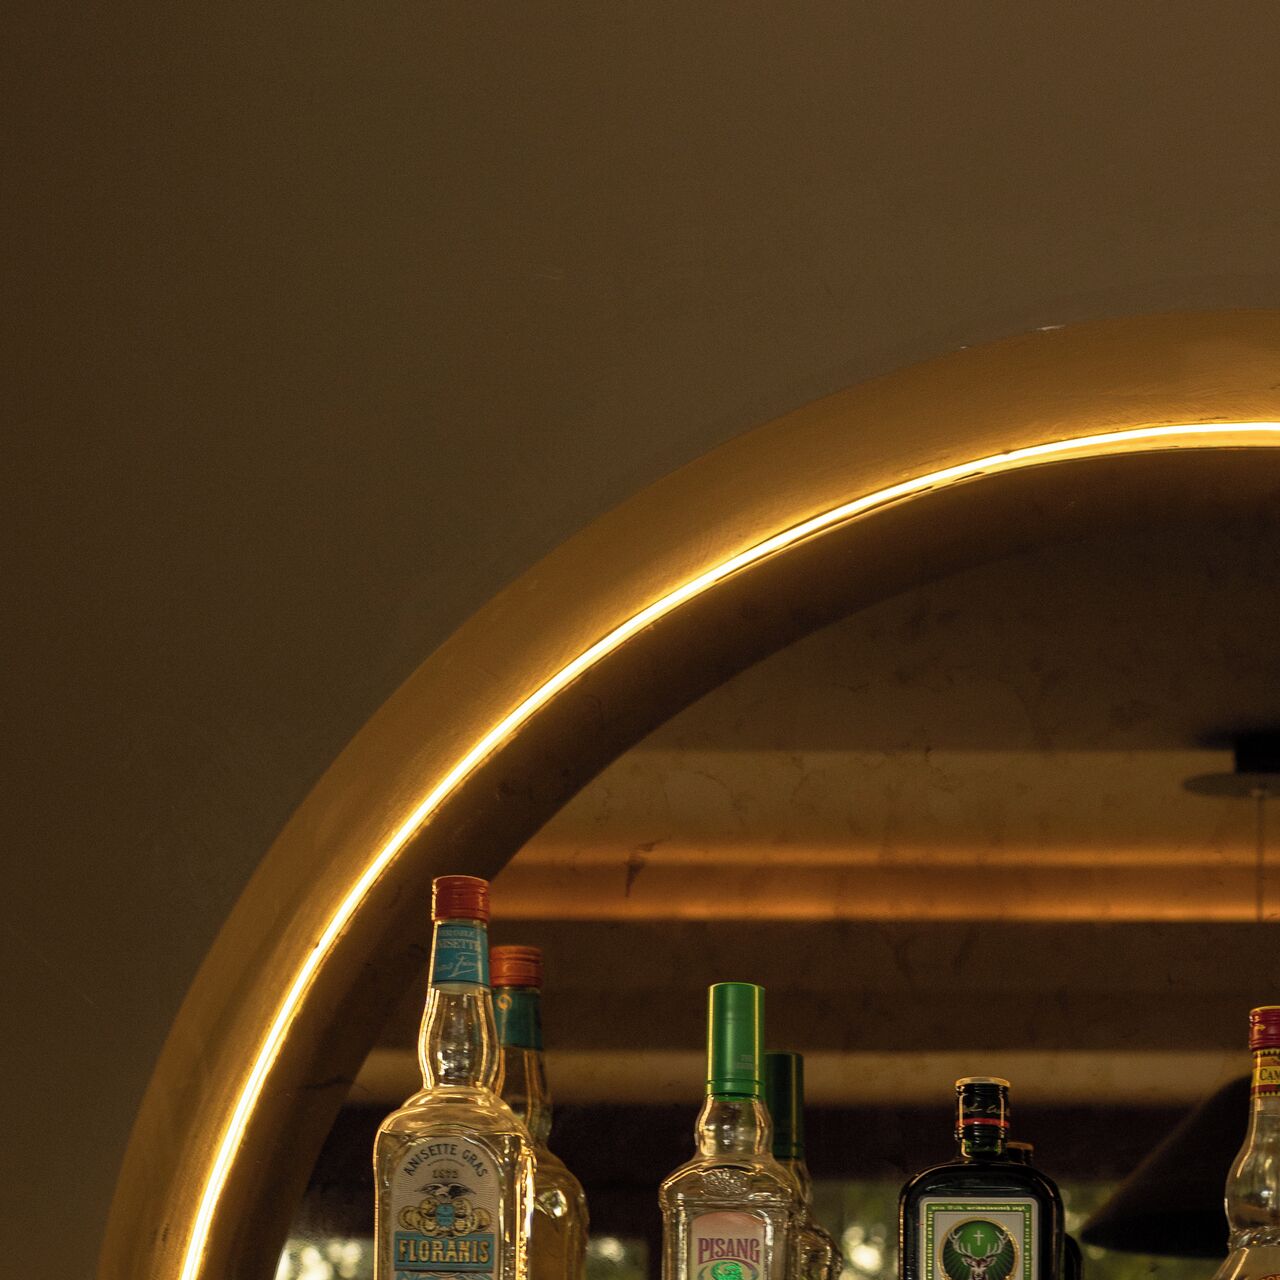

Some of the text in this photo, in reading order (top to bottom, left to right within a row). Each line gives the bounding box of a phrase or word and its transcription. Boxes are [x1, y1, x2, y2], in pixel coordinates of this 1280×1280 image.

[403, 1143, 488, 1177] ANISETTE GRAS
[398, 1239, 490, 1263] FLORANIS
[696, 1237, 761, 1265] PISANG
